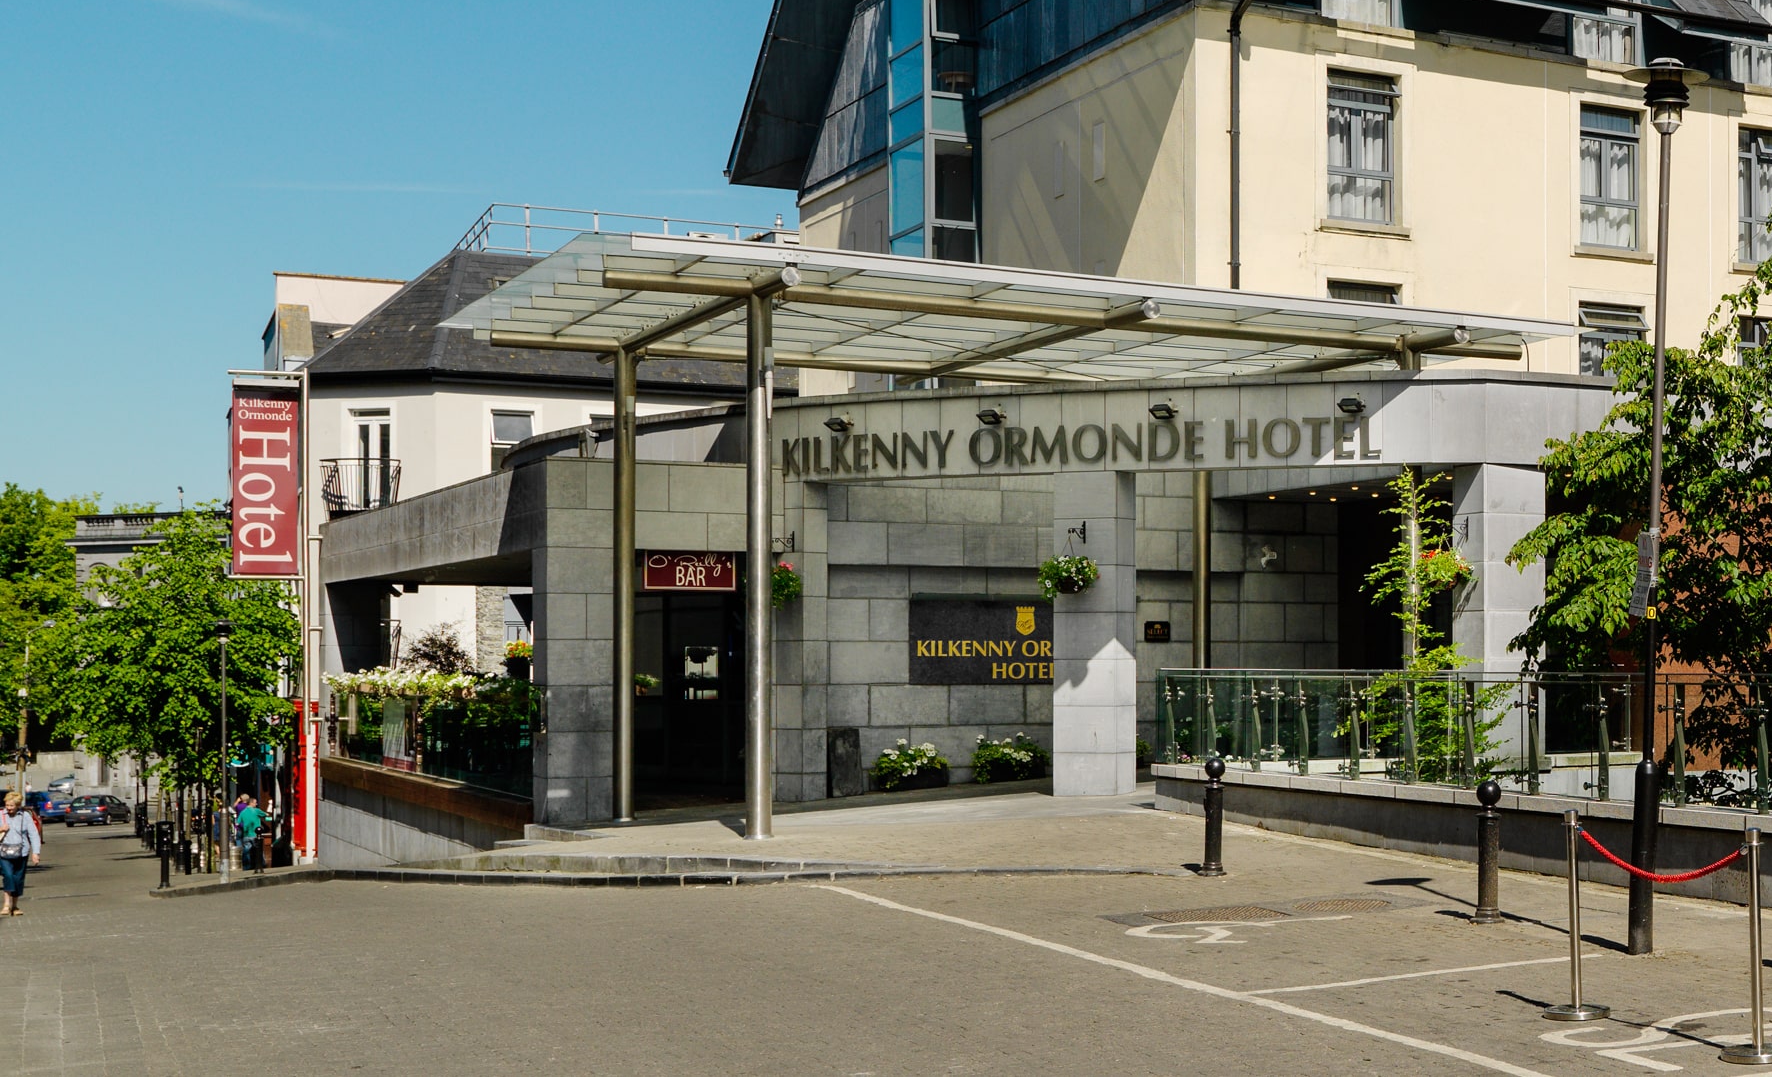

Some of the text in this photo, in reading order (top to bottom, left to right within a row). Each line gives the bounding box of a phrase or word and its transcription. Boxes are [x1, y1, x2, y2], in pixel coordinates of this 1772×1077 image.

[239, 398, 292, 411] Kilkenny
[238, 409, 293, 421] Ormonde
[782, 416, 1381, 475] KILKENNY ORMONDE HOTEL
[238, 425, 293, 566] Hotel
[675, 566, 706, 586] BAR
[917, 640, 1054, 657] KILKENNY OR
